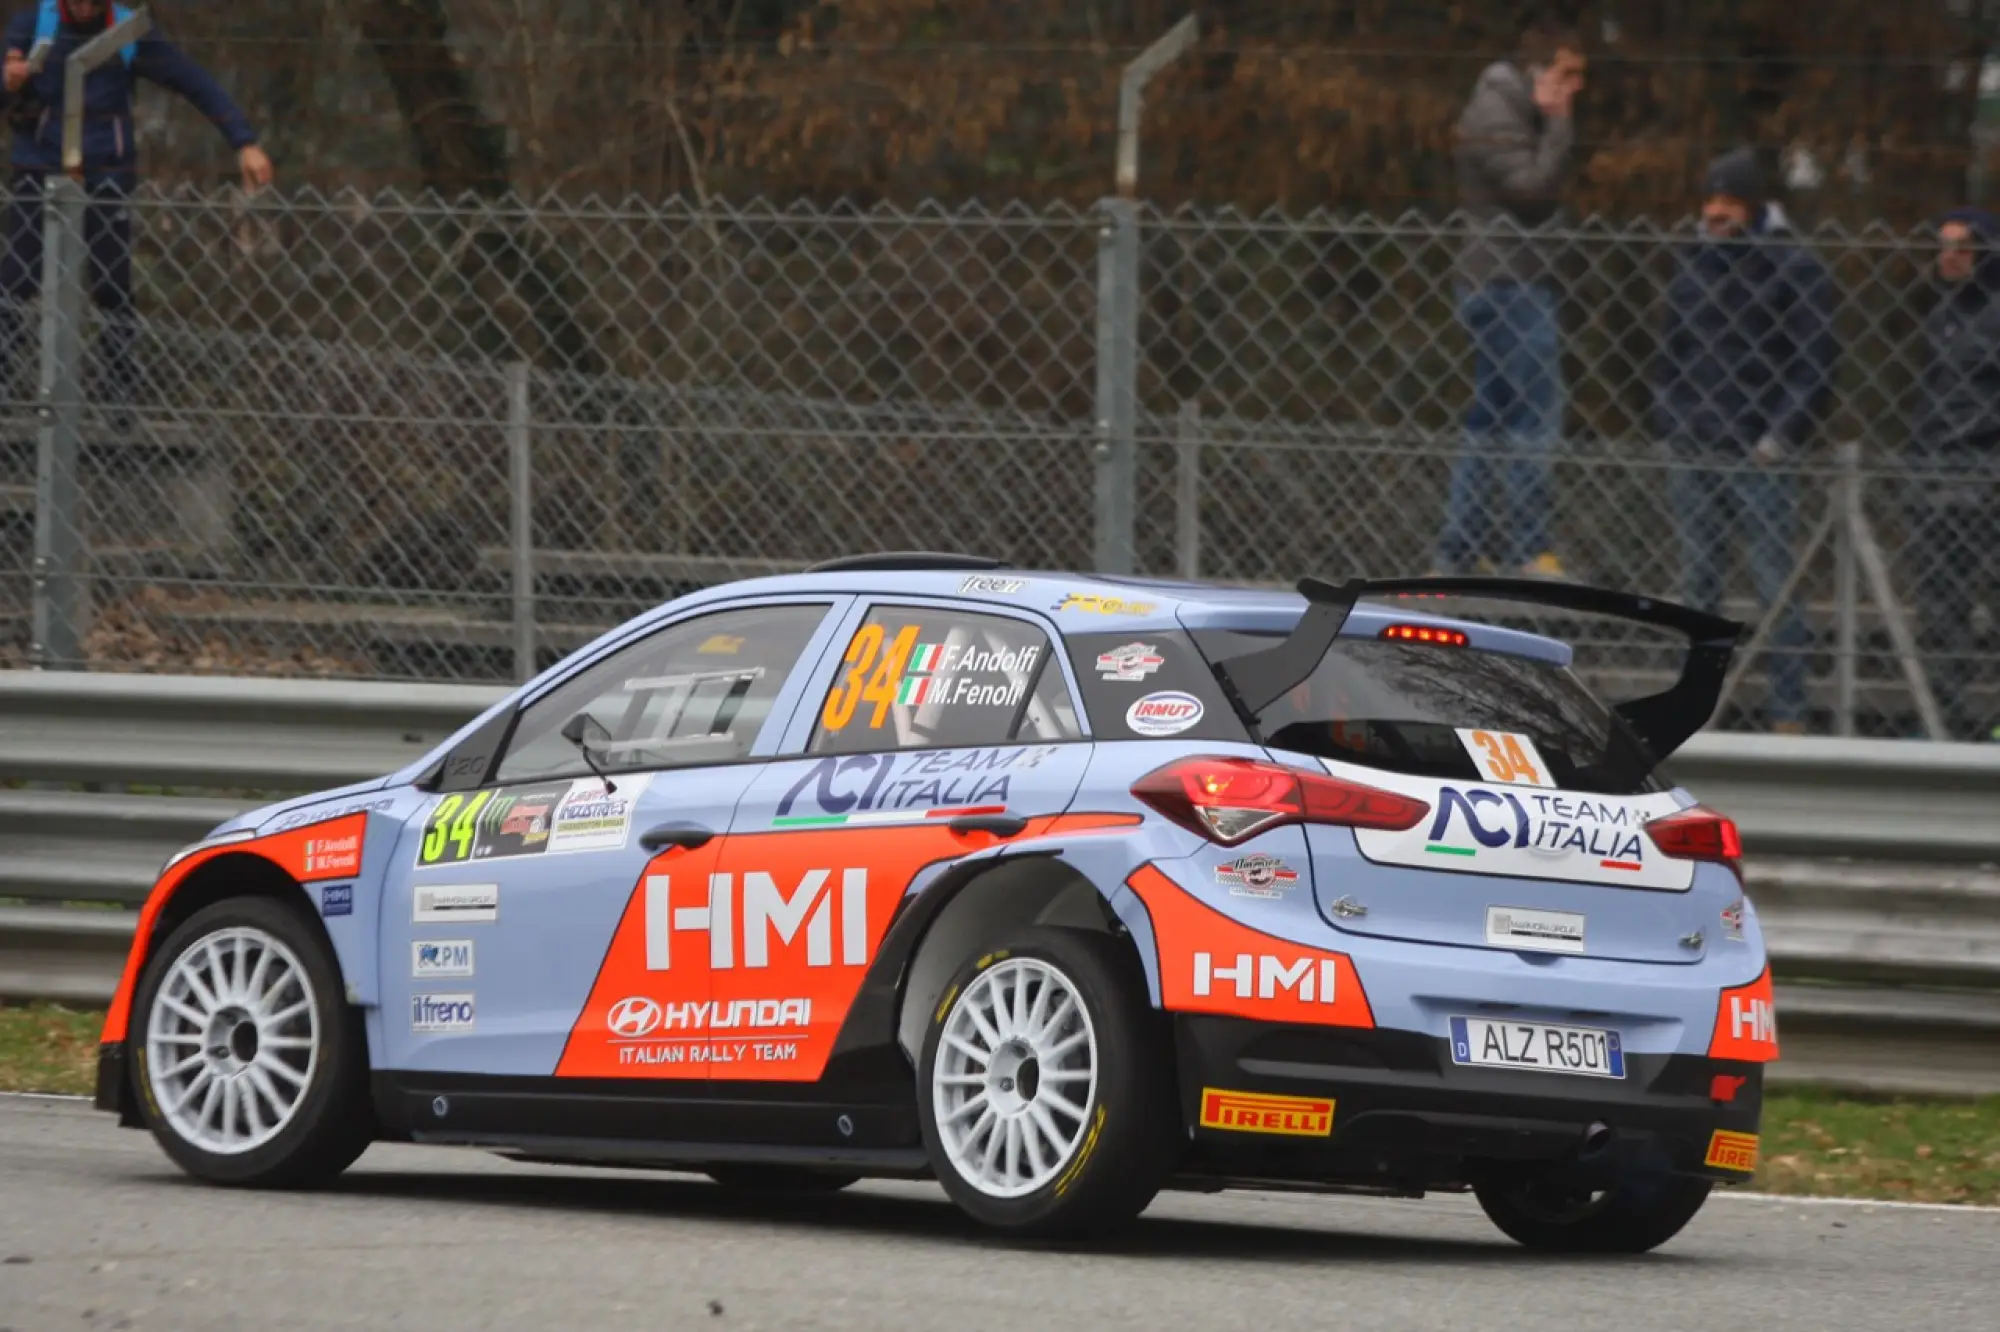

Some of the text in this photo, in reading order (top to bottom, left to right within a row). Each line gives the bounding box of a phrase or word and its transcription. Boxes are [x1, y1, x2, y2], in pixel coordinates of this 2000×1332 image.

[822, 623, 921, 732] 34
[941, 643, 1040, 673] F.Andolfi
[1135, 701, 1194, 717] IRMUT
[900, 747, 1028, 777] TEAM
[1472, 729, 1540, 785] 34
[775, 754, 897, 816] ACI
[875, 773, 1012, 810] ITALIA
[423, 791, 492, 863] 34
[1428, 786, 1531, 849] ACI
[1531, 794, 1629, 827] TEAM
[1535, 820, 1644, 863] ITALIA
[645, 867, 868, 971] HMI
[1193, 952, 1336, 1004] HMI
[664, 998, 812, 1029] HYUNDAI
[619, 1042, 797, 1065] ITALIAN RALLY TEAM
[1457, 1042, 1467, 1058] D
[1482, 1023, 1609, 1069] ALZ R501
[1205, 1094, 1331, 1133] PIRELLI
